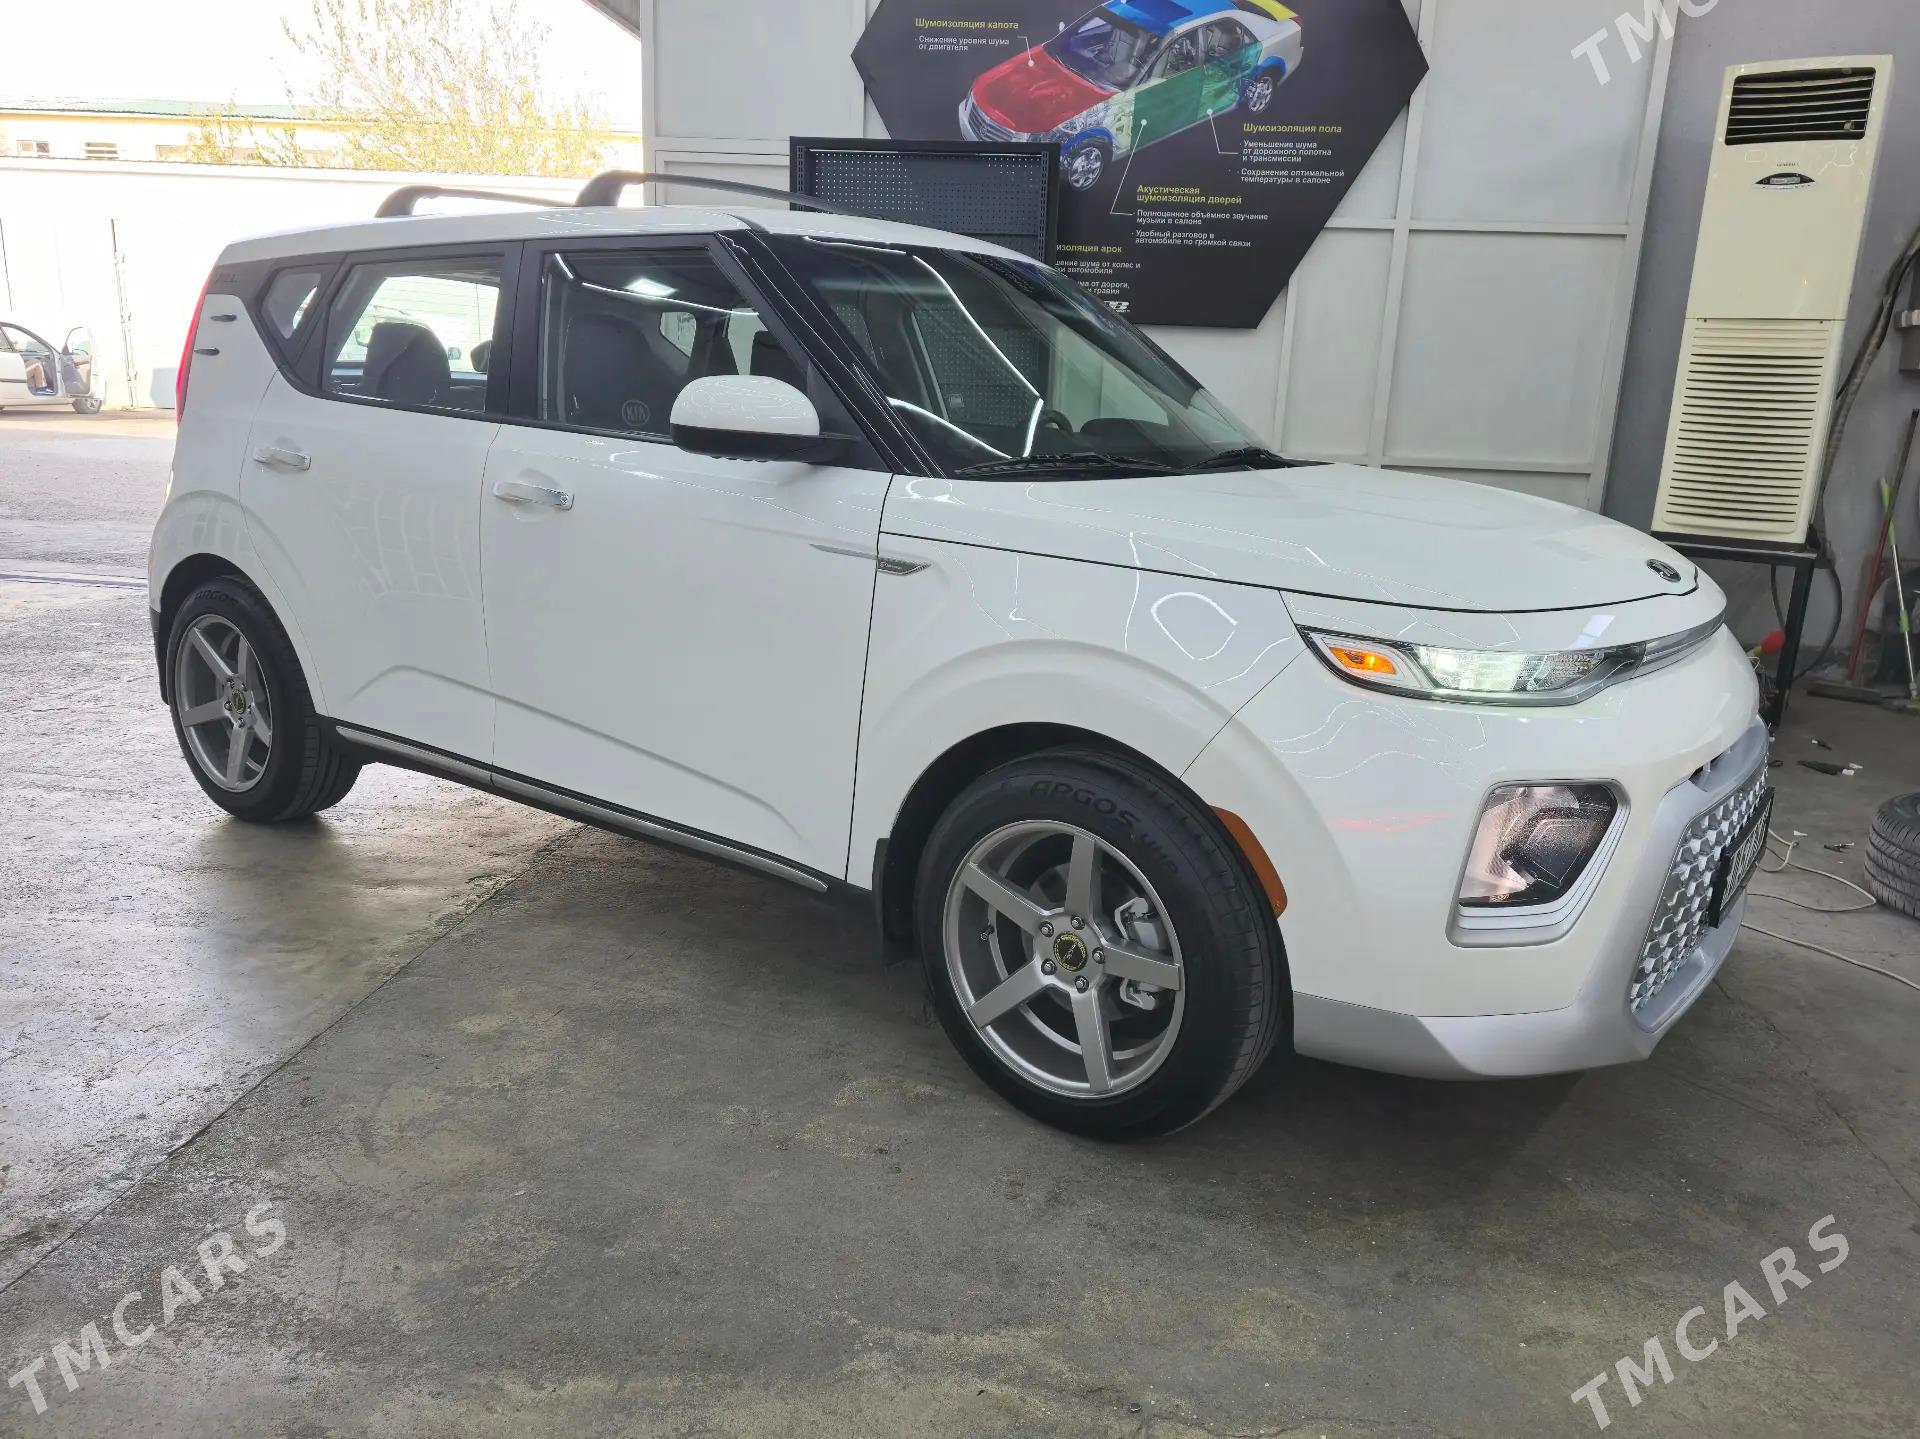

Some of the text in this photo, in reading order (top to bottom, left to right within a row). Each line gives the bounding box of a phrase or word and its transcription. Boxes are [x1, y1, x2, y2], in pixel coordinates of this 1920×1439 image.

[916, 18, 1019, 30] Шумоизоляция капота
[918, 35, 957, 44] Снижение
[1243, 123, 1342, 134] Шумоизоляция пола
[1244, 140, 1294, 148] Уменьшение
[1253, 148, 1297, 156] дорожного
[1241, 168, 1288, 176] Сохранение
[1241, 176, 1293, 184] температуры
[1137, 185, 1200, 195] Акустическая
[1137, 194, 1242, 205] шумоизоляция дверей
[1137, 209, 1268, 221] Полноценное объёмное звучание
[1136, 230, 1170, 239] Удобный
[1172, 232, 1208, 240] разговор
[1194, 238, 1226, 246] громкой
[1100, 281, 1130, 289] дороги,
[1030, 779, 1140, 826] ARGOS
